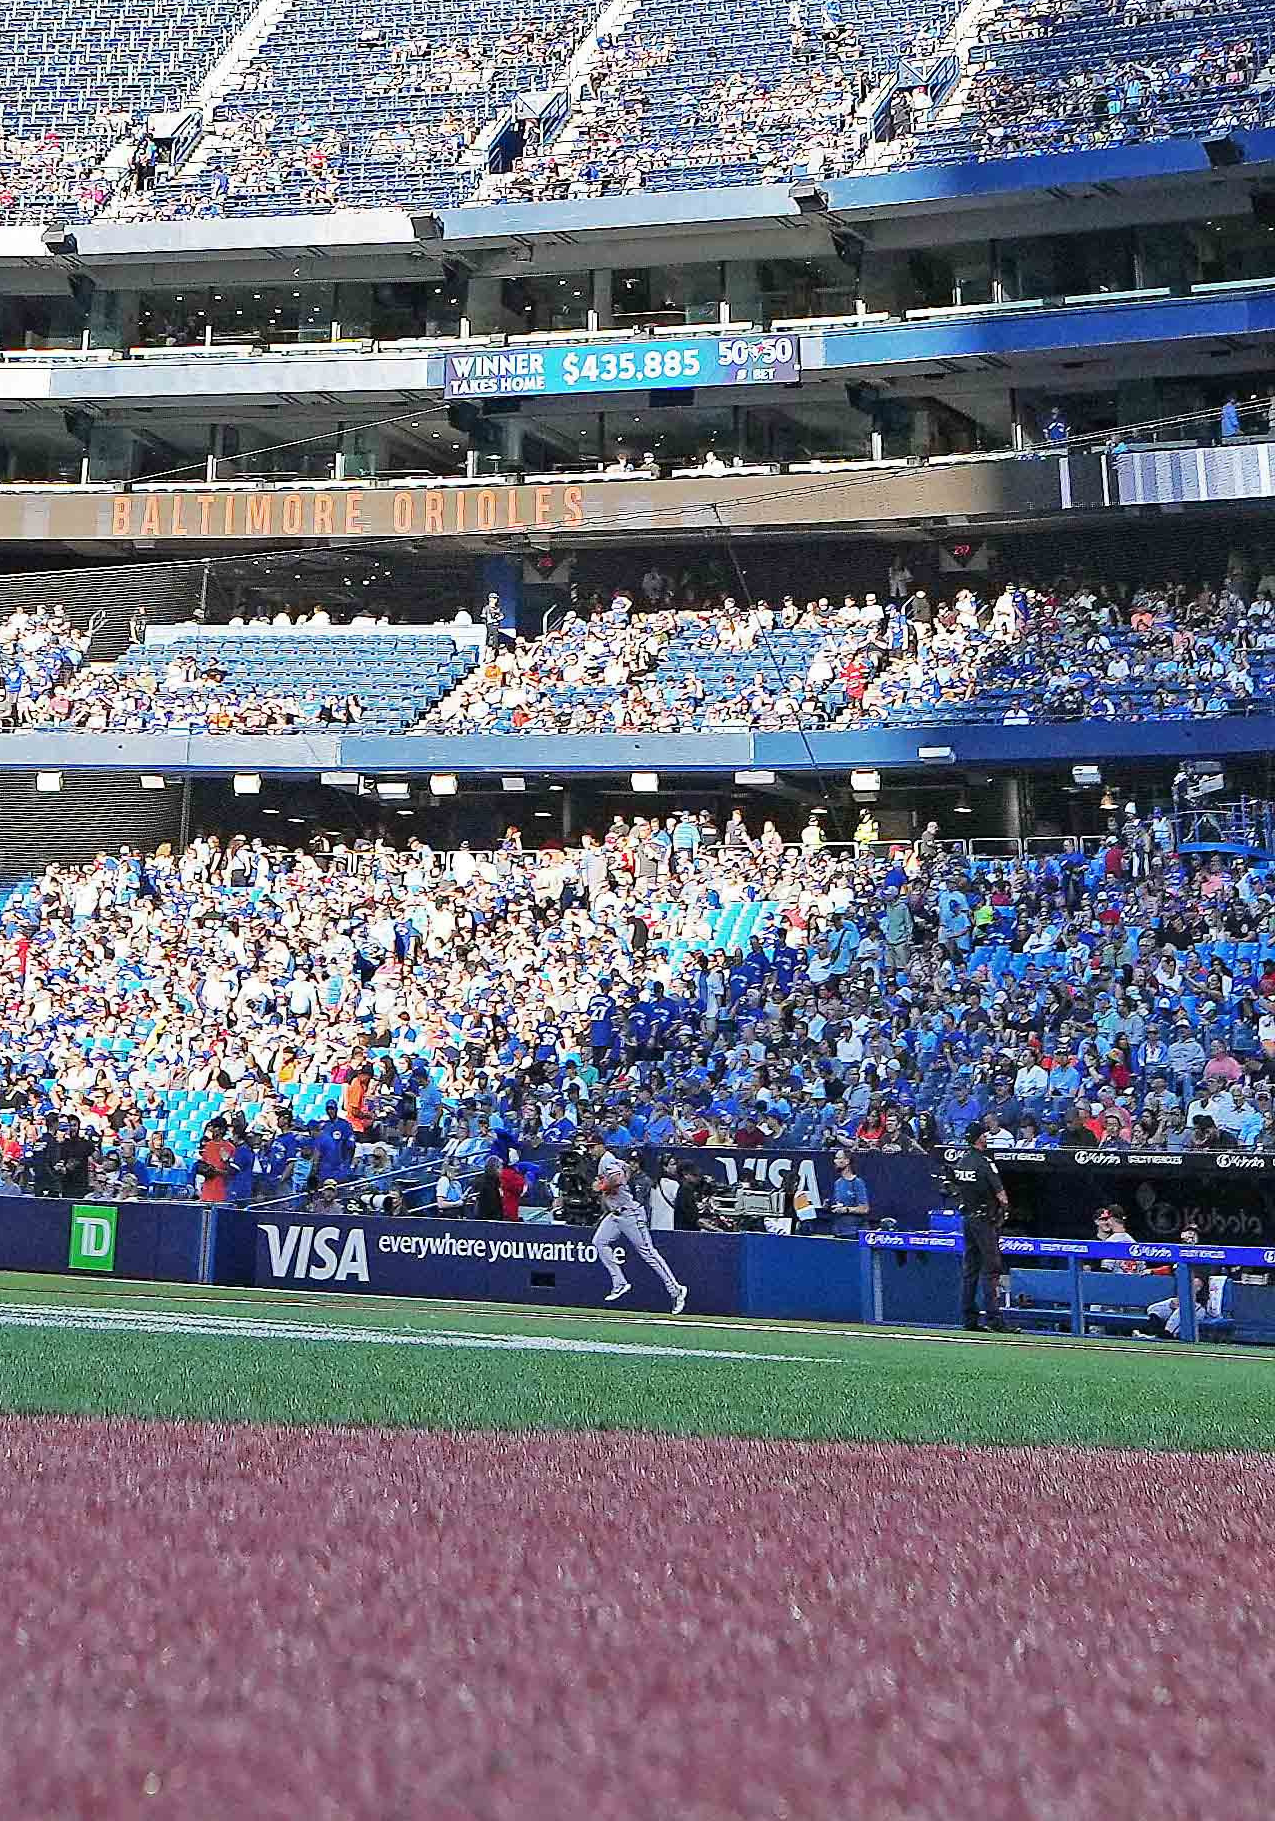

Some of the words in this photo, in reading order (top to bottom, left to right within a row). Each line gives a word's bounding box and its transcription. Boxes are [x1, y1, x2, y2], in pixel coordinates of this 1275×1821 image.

[451, 353, 545, 377] WINNER
[562, 349, 701, 386] $435,885
[450, 378, 498, 395] TAKES
[500, 375, 547, 392] HOME
[112, 490, 365, 536] BALTIMORE
[393, 486, 584, 534] ORIOLES
[75, 1216, 111, 1256] TD
[257, 1224, 370, 1283] VISA
[378, 1233, 487, 1259] everywhere
[488, 1240, 526, 1263] you
[526, 1241, 575, 1262] want
[576, 1241, 598, 1263] to
